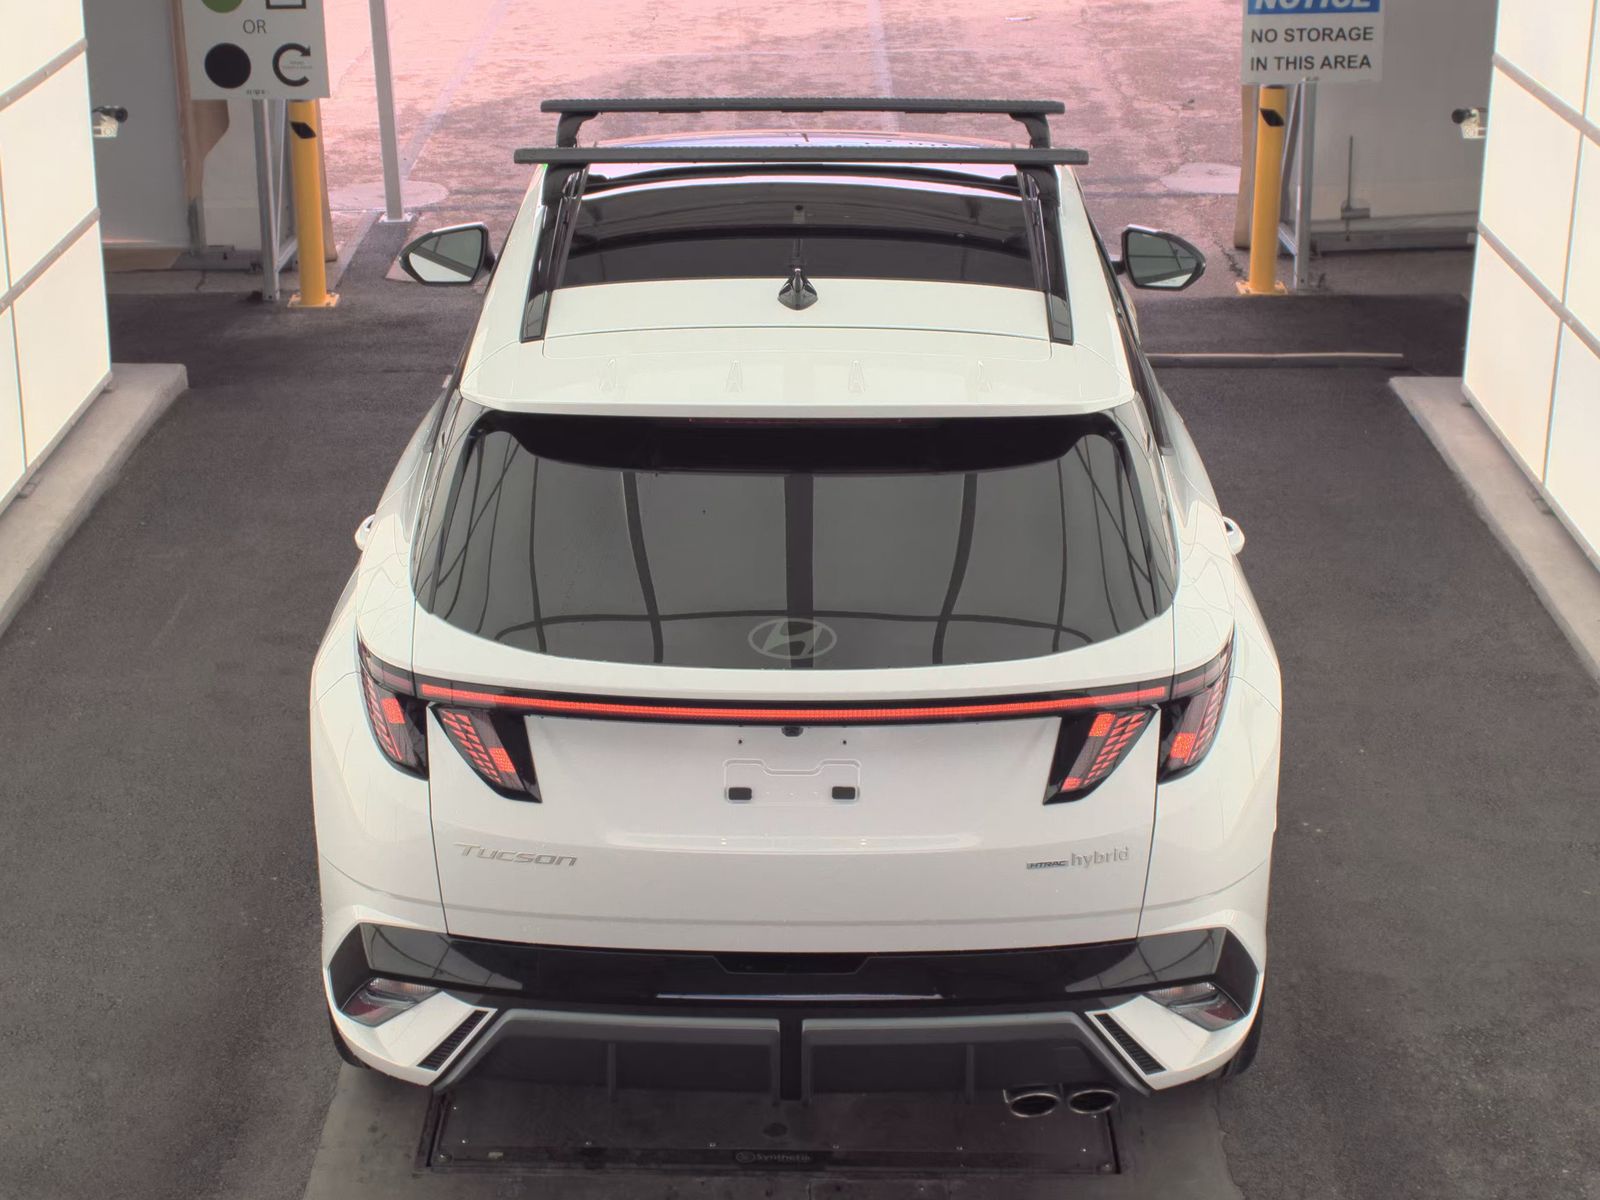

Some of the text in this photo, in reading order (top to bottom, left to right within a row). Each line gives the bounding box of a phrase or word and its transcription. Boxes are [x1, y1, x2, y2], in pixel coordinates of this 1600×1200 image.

[243, 19, 267, 34] OR
[1251, 26, 1374, 43] NO STORAGE
[1251, 55, 1371, 71] IN THIS AREA
[1071, 846, 1129, 868] hybrid
